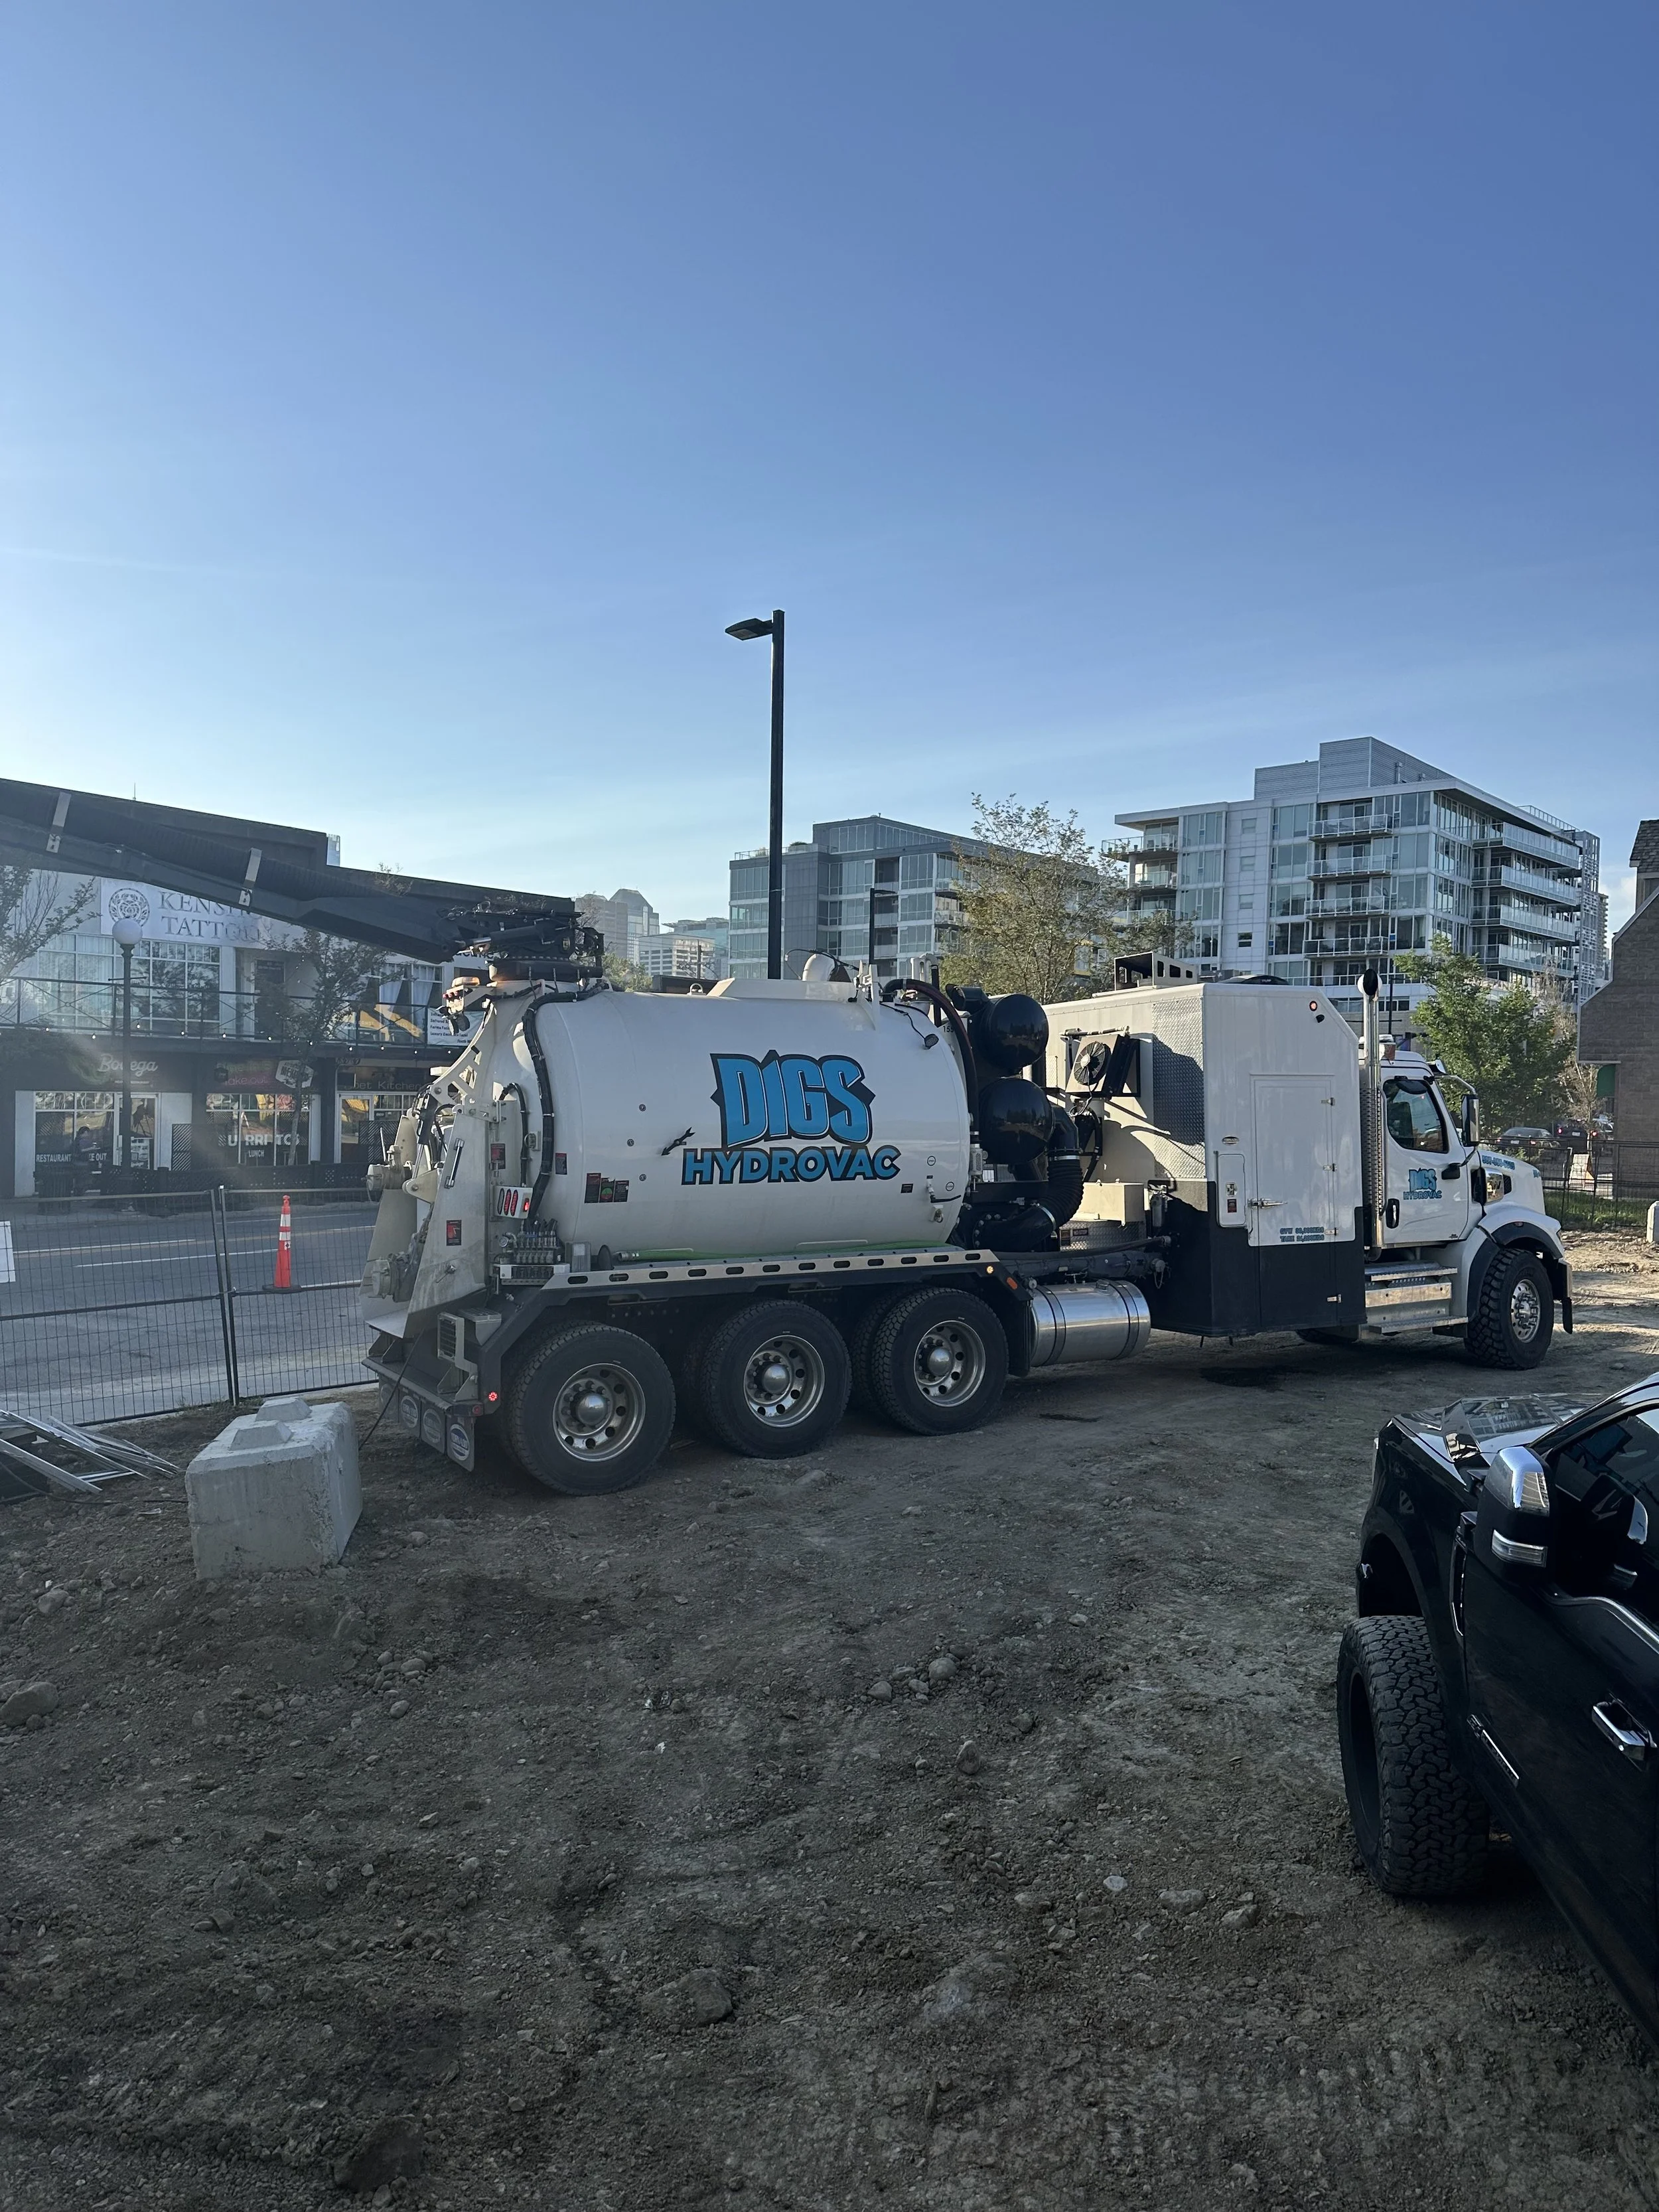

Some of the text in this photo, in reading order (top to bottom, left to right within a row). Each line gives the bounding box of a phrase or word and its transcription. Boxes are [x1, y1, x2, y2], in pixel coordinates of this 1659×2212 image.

[378, 1080, 421, 1090] Kitchen
[711, 1051, 873, 1148] DIGS
[36, 1153, 72, 1163] RESTAURANT
[682, 1145, 901, 1185] HYDROVAC
[1408, 1168, 1437, 1192] DIGS
[1403, 1191, 1443, 1200] HYDROVAC
